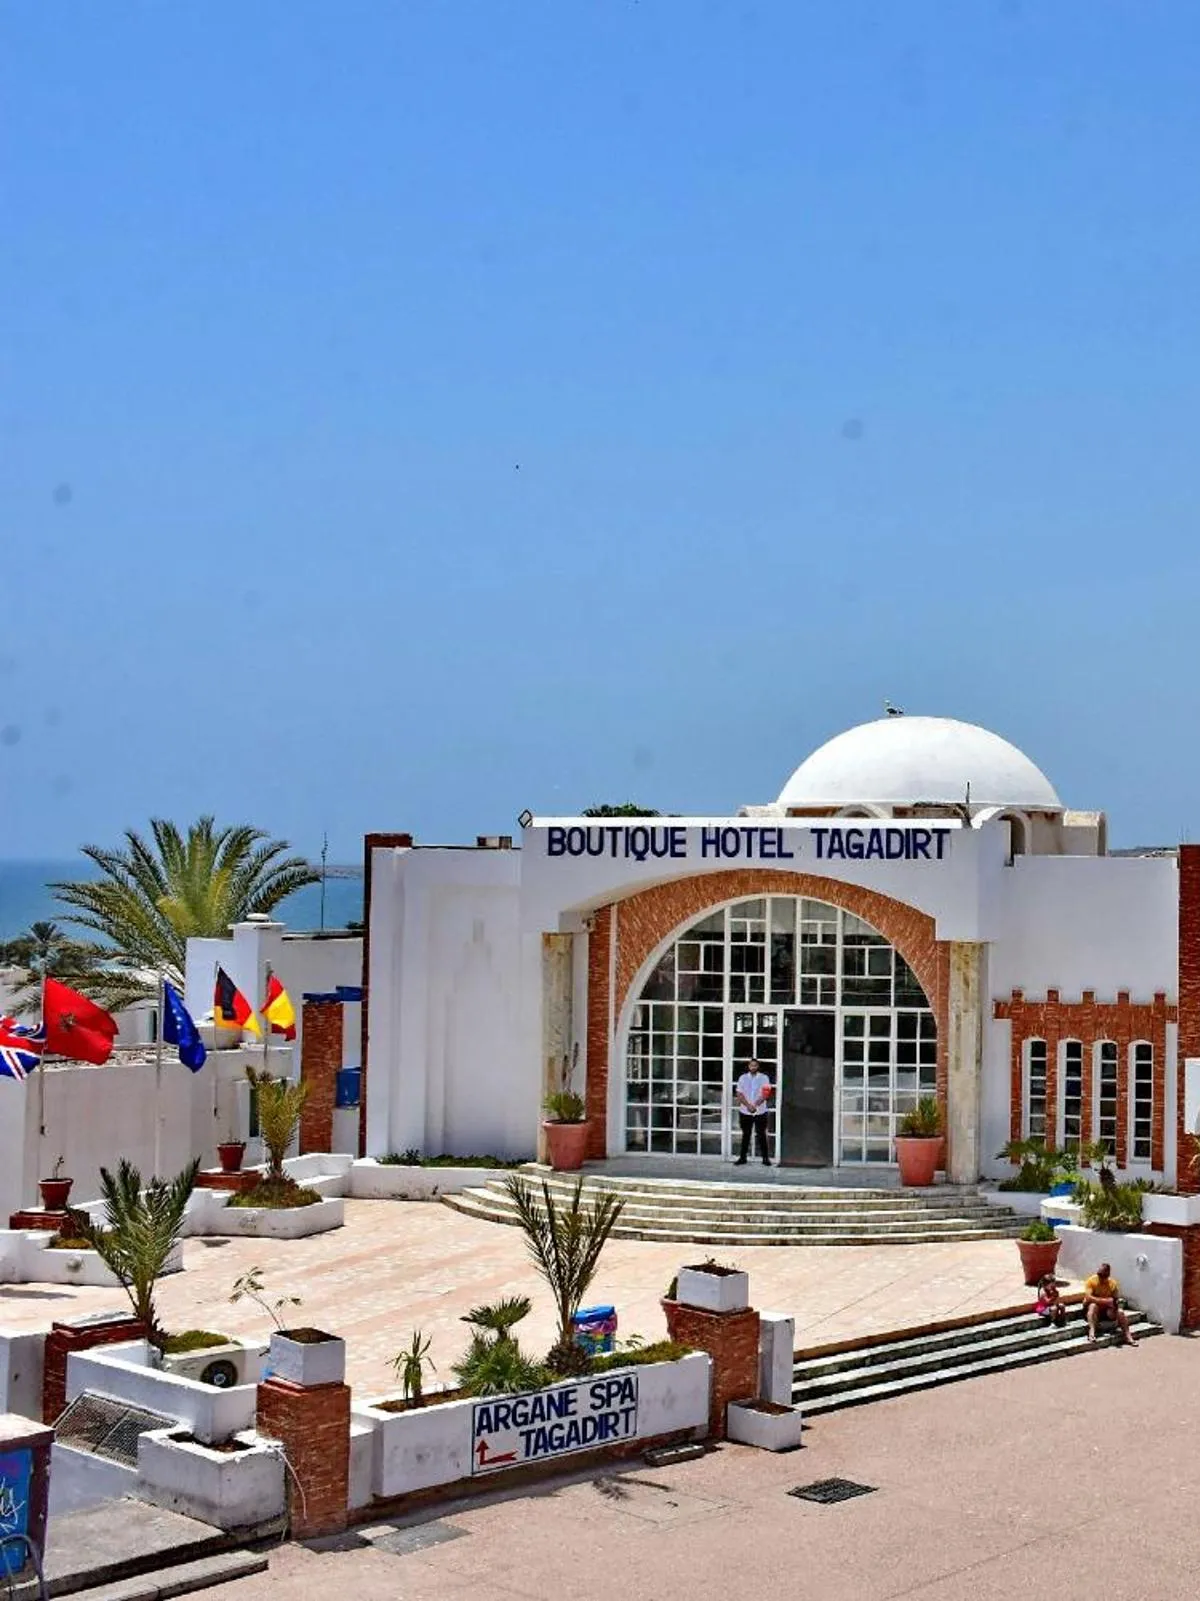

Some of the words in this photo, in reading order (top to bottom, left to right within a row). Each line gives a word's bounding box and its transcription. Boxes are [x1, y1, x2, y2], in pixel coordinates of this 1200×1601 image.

[548, 827, 687, 861] BOUTIQUE
[701, 827, 794, 859] HOTEL
[810, 828, 951, 860] TAGADIRT
[476, 1388, 578, 1437] ARGANE
[589, 1377, 635, 1411] SPA
[519, 1406, 636, 1457] TAGADIRT
